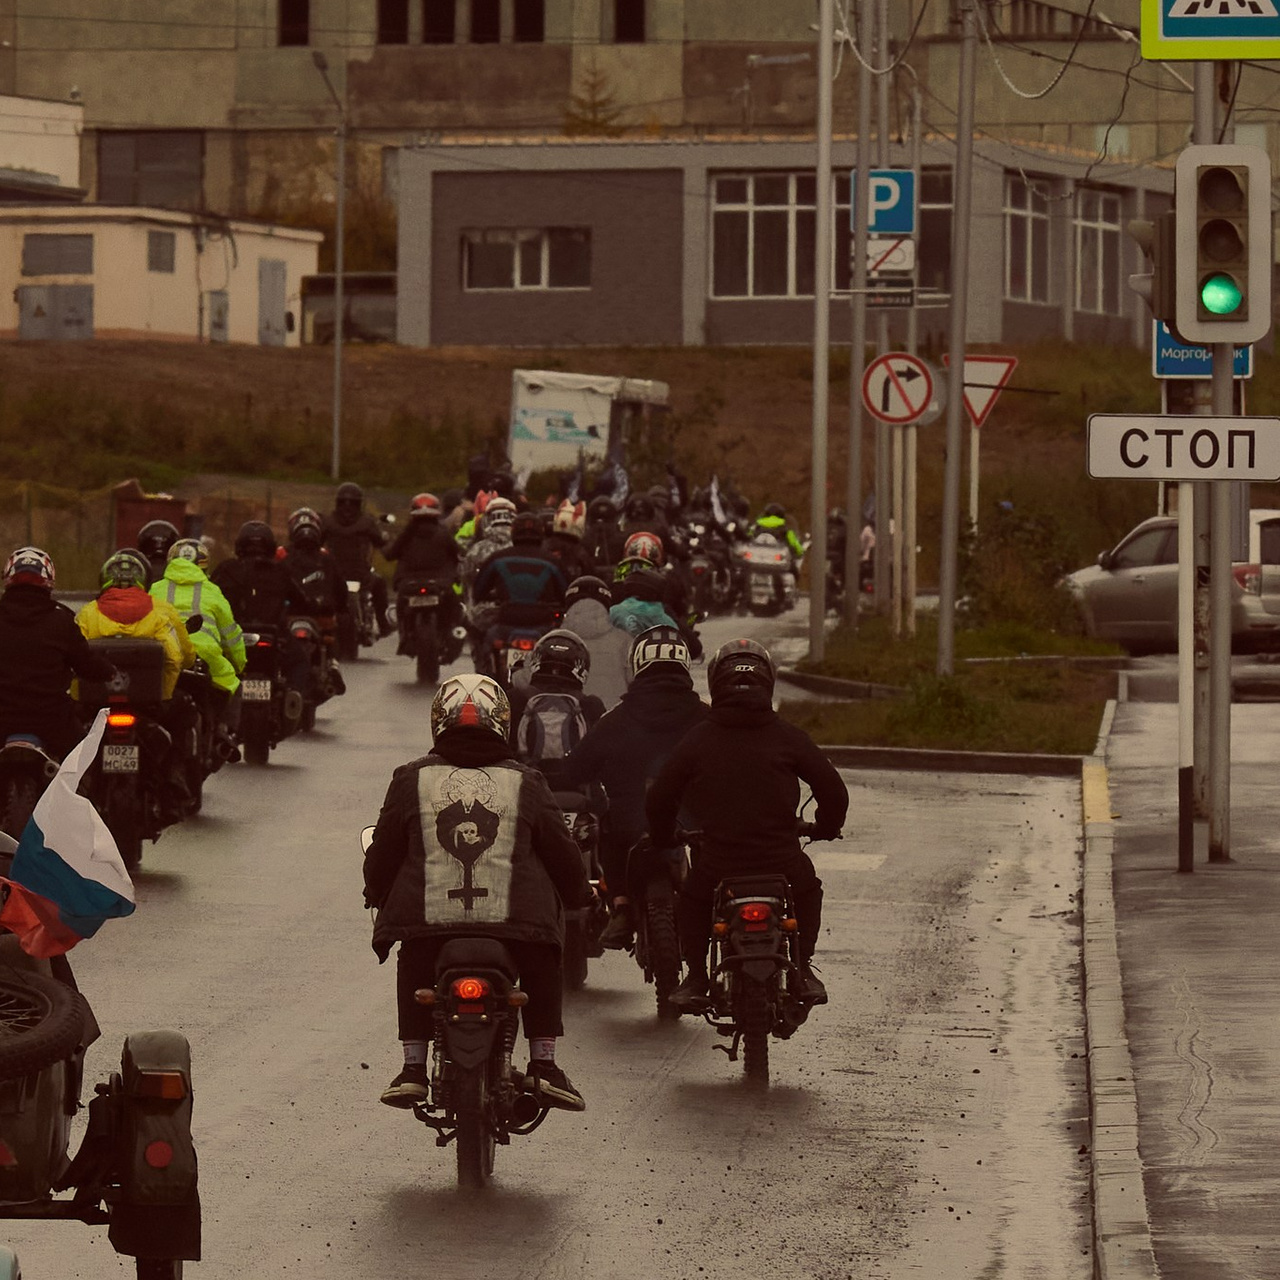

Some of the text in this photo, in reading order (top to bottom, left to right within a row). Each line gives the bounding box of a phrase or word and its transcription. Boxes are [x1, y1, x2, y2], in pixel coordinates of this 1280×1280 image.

[1161, 347, 1244, 362] Моргорк
[1120, 428, 1255, 469] СТОП
[107, 746, 134, 756] 0027
[123, 760, 136, 769] 49
